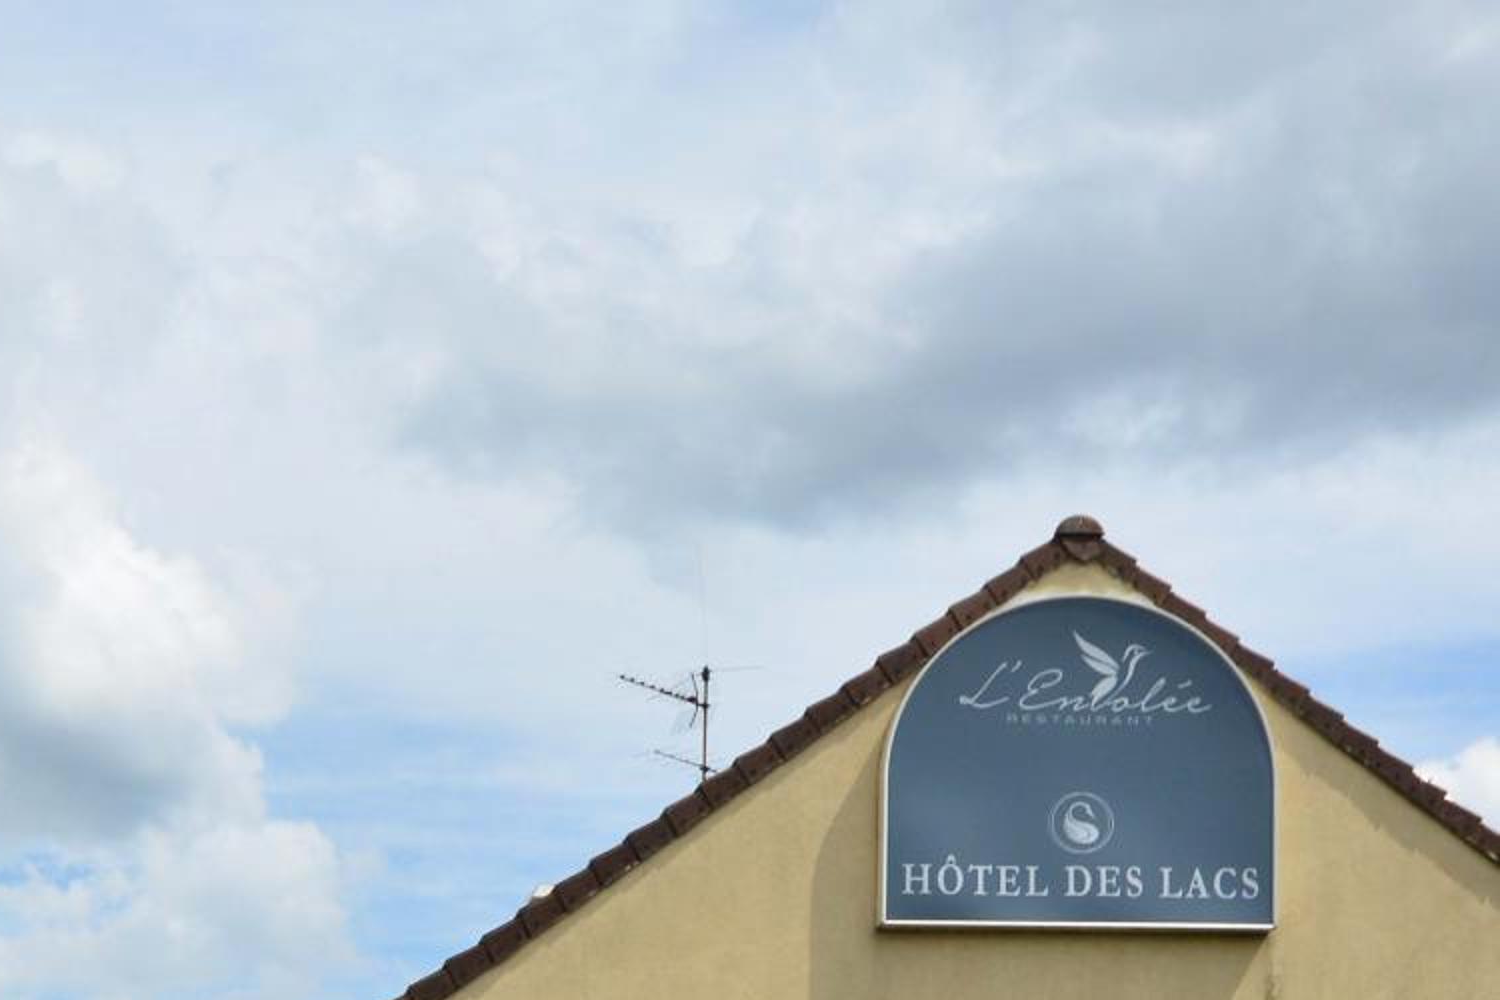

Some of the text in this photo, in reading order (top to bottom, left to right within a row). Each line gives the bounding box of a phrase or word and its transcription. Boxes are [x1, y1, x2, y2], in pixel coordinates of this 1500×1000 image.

[901, 854, 1260, 900] HÔTEL DES LACS
